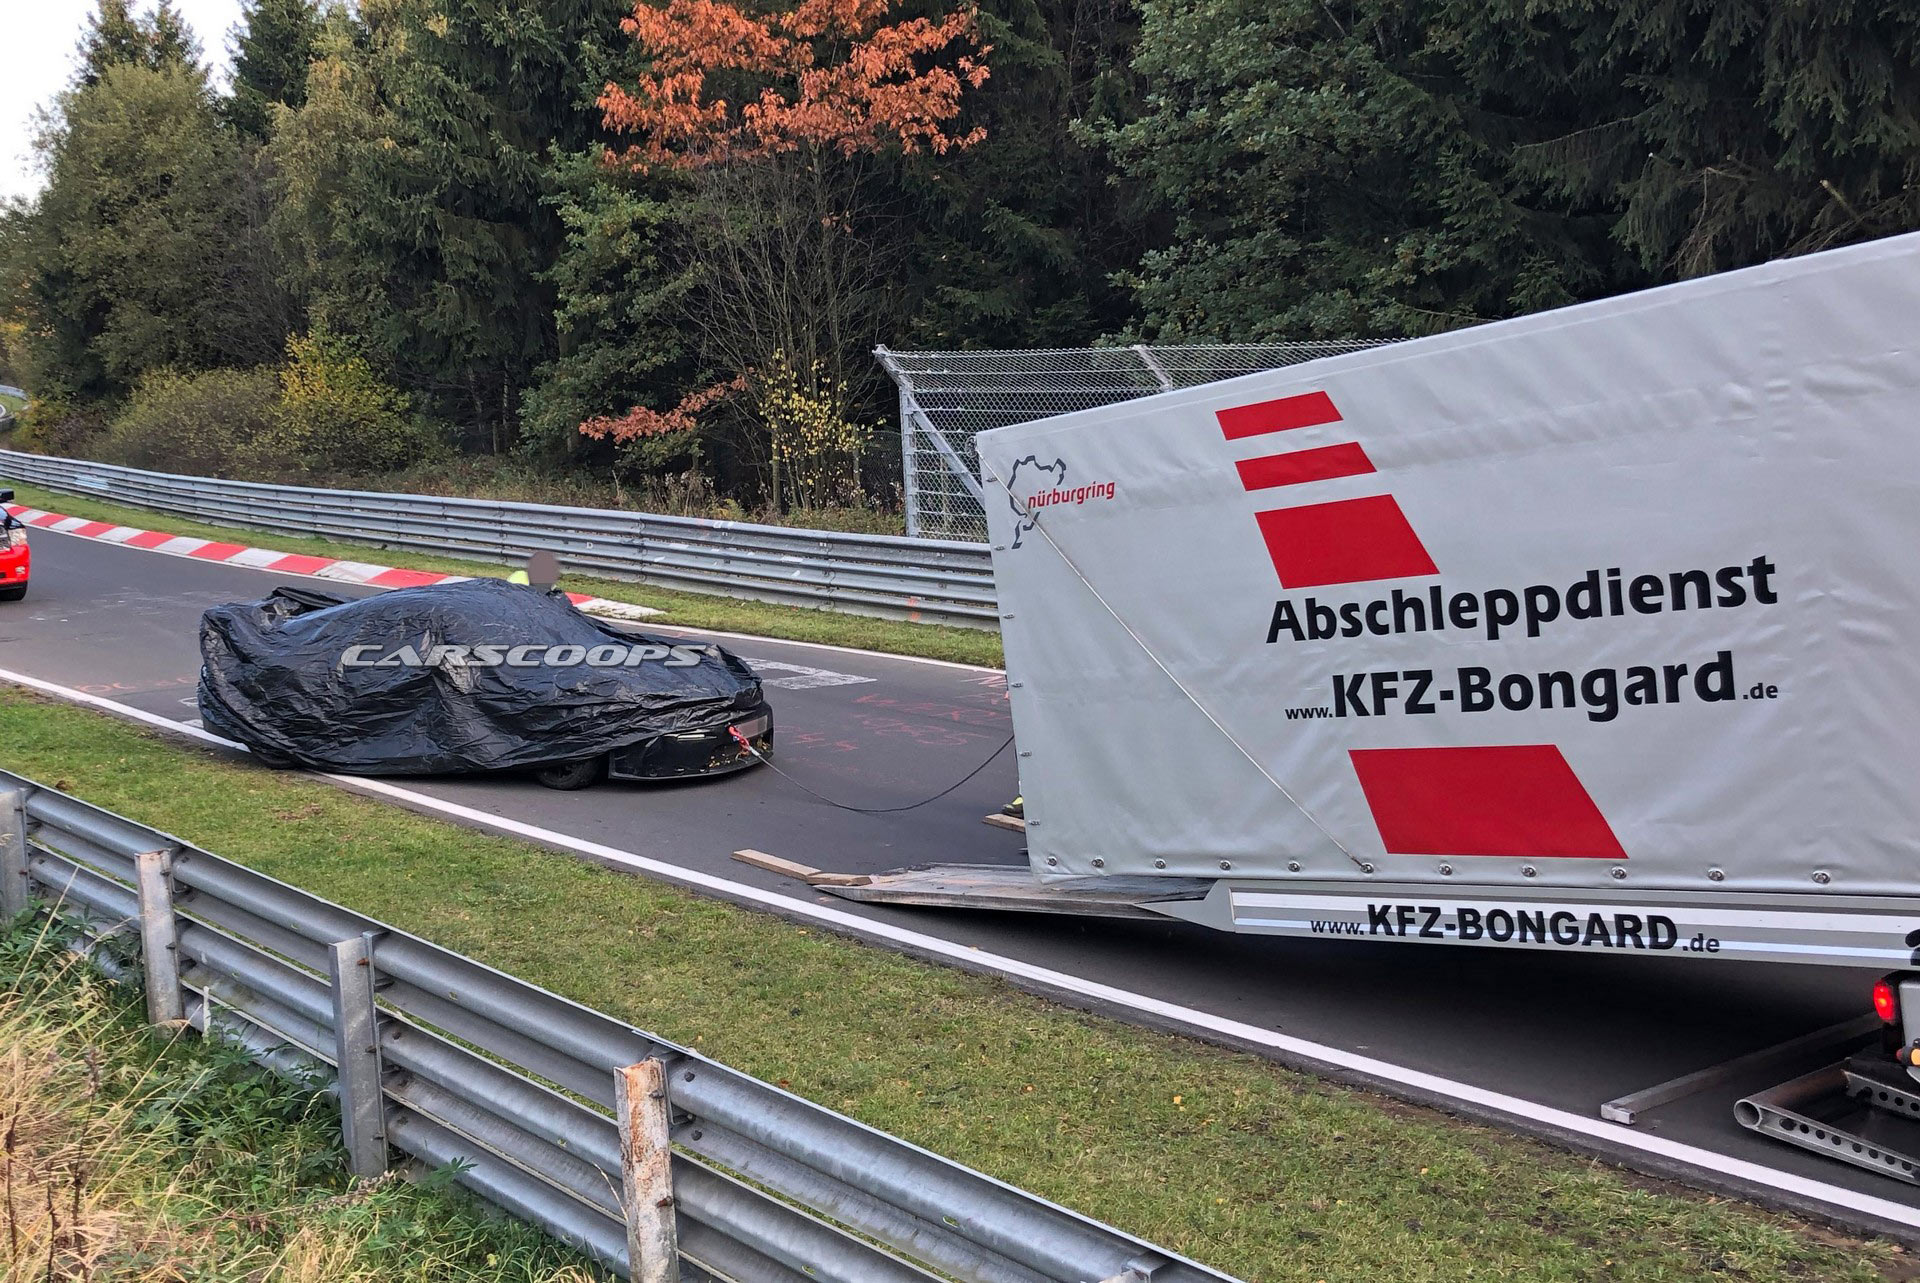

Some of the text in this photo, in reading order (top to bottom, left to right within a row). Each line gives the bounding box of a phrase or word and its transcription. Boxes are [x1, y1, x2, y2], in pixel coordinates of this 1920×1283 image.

[1028, 481, 1115, 509] nürburgring
[1266, 556, 1777, 643] Abschleppdienst
[1286, 651, 1778, 722] www.KFZ-Bongard.de
[1311, 904, 1720, 953] www.KFZ-BONGARD.de
